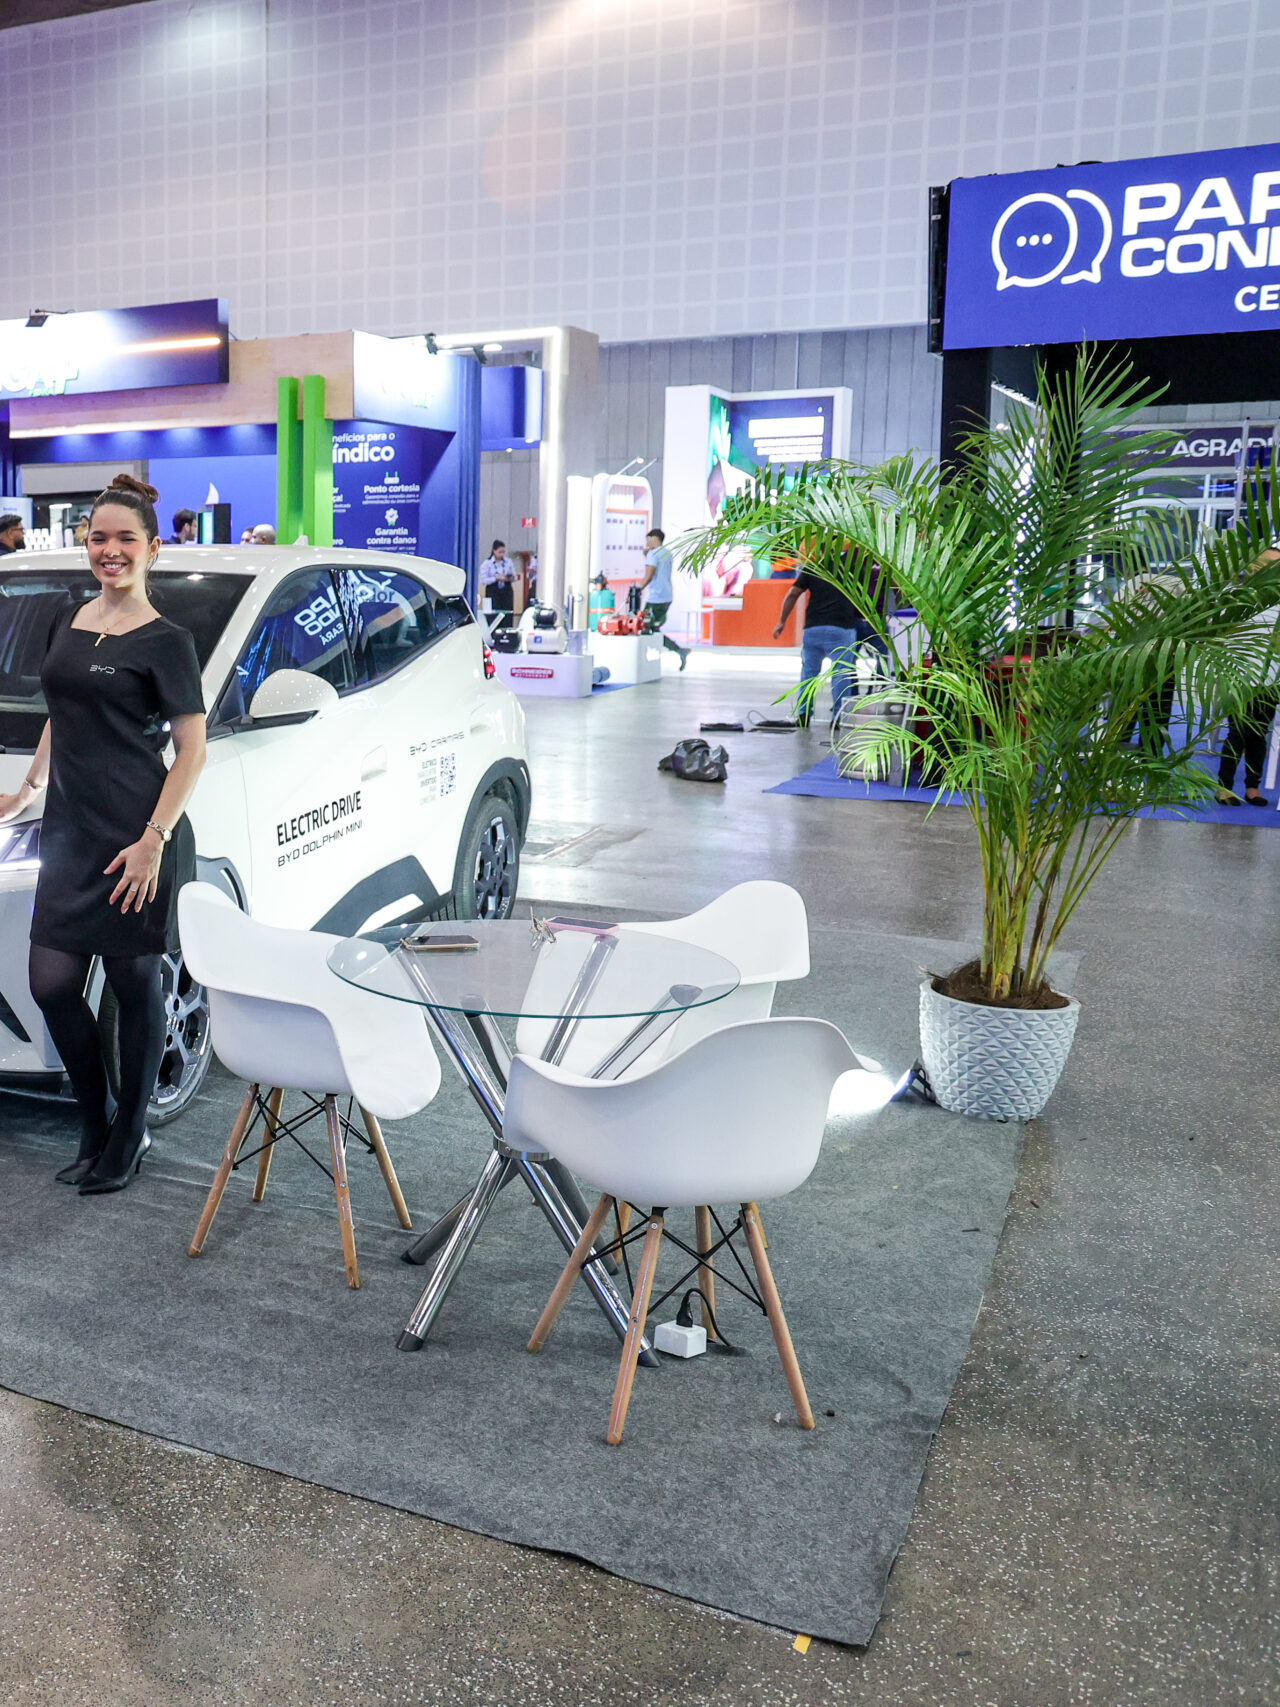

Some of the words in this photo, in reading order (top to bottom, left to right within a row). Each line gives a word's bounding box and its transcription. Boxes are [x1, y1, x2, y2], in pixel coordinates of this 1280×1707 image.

[367, 432, 387, 443] para
[364, 485, 387, 493] Ponto
[389, 483, 420, 492] cortesia
[375, 527, 408, 536] Garantia
[366, 536, 391, 545] contra
[393, 535, 417, 544] danos
[89, 664, 116, 675] BYD
[277, 804, 330, 846] ELECTRIC
[332, 790, 362, 821] DRIVE
[278, 848, 301, 867] BYD
[302, 829, 343, 856] DOLPHIN
[345, 819, 363, 836] MINI
